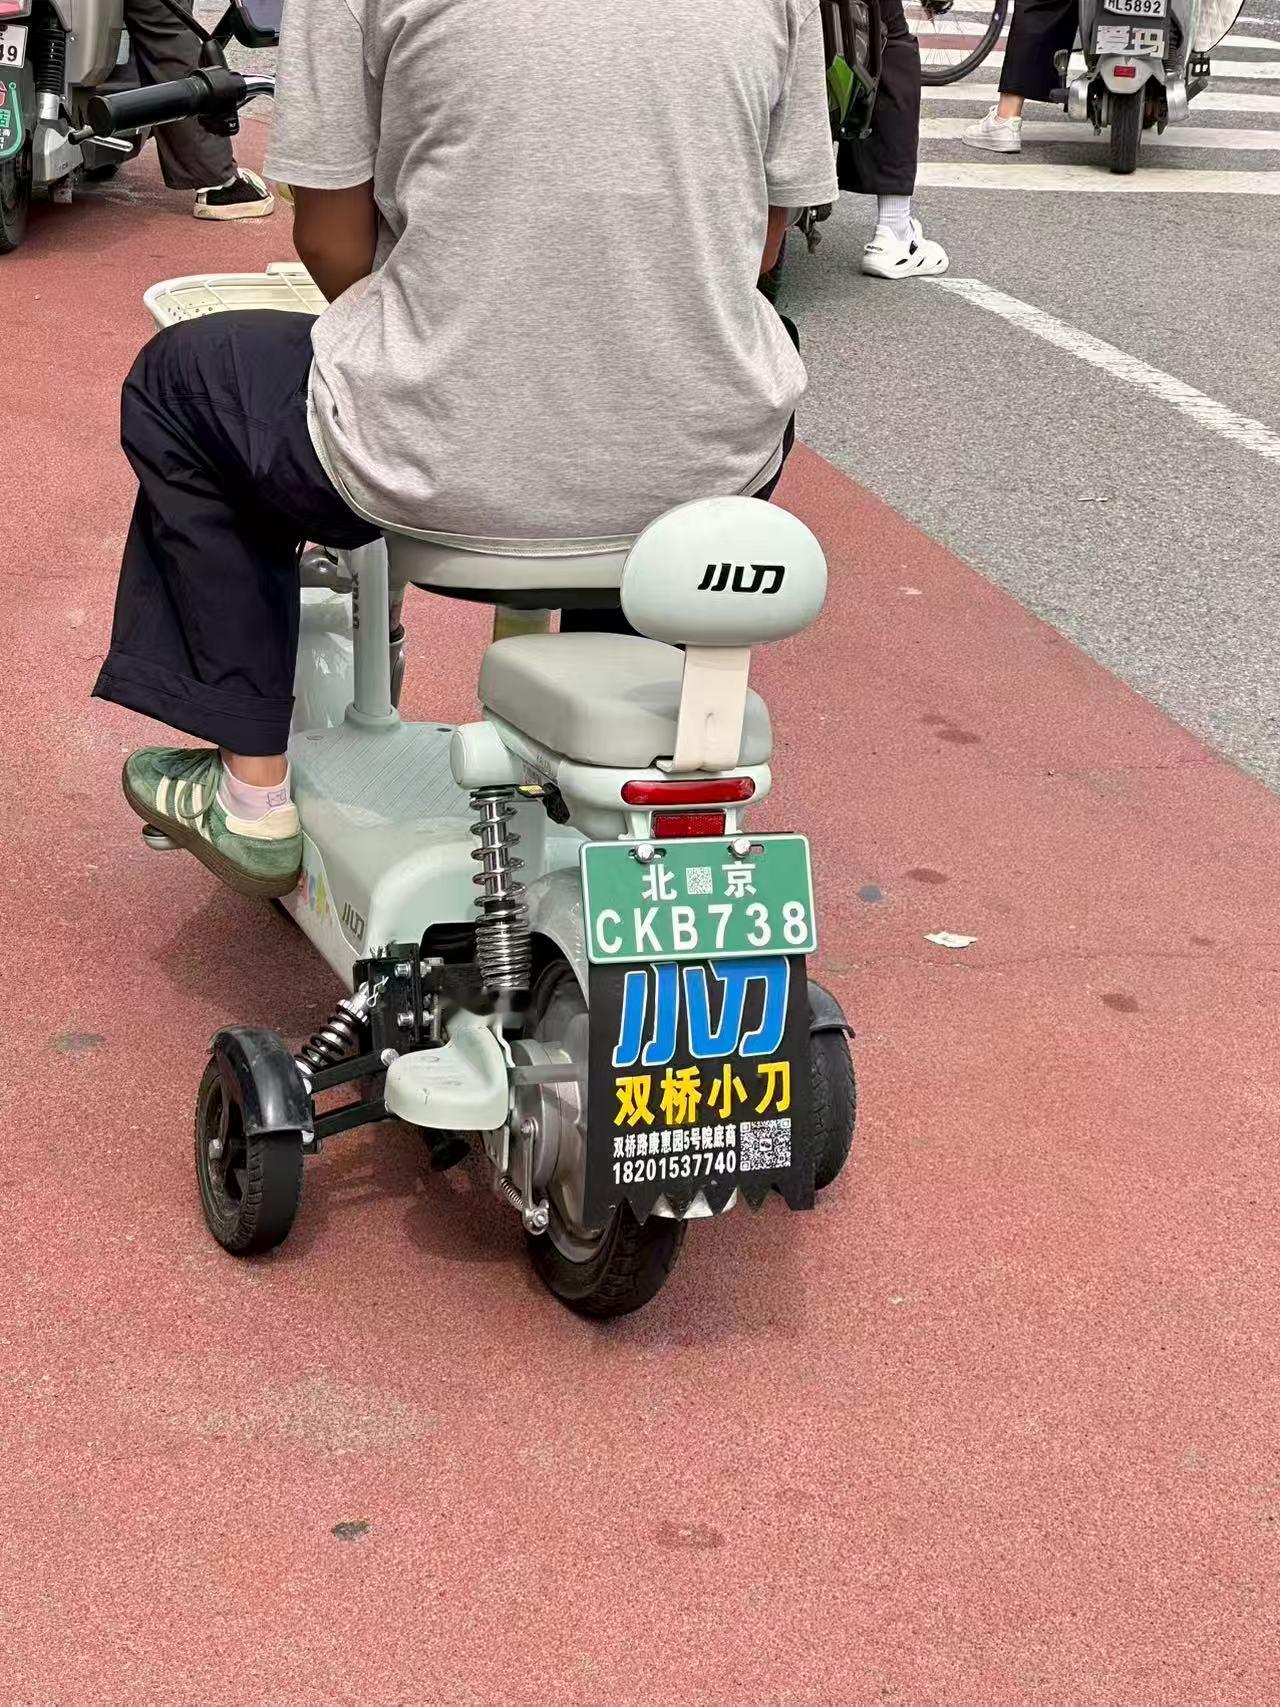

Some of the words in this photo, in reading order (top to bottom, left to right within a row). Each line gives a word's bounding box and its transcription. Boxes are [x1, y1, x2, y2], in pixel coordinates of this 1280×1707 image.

[595, 901, 808, 954] CKB738
[613, 1061, 791, 1127] 双桥小刀
[613, 1124, 737, 1158] 双桥路康惠园5号院底商
[613, 1150, 737, 1184] 18201537740
